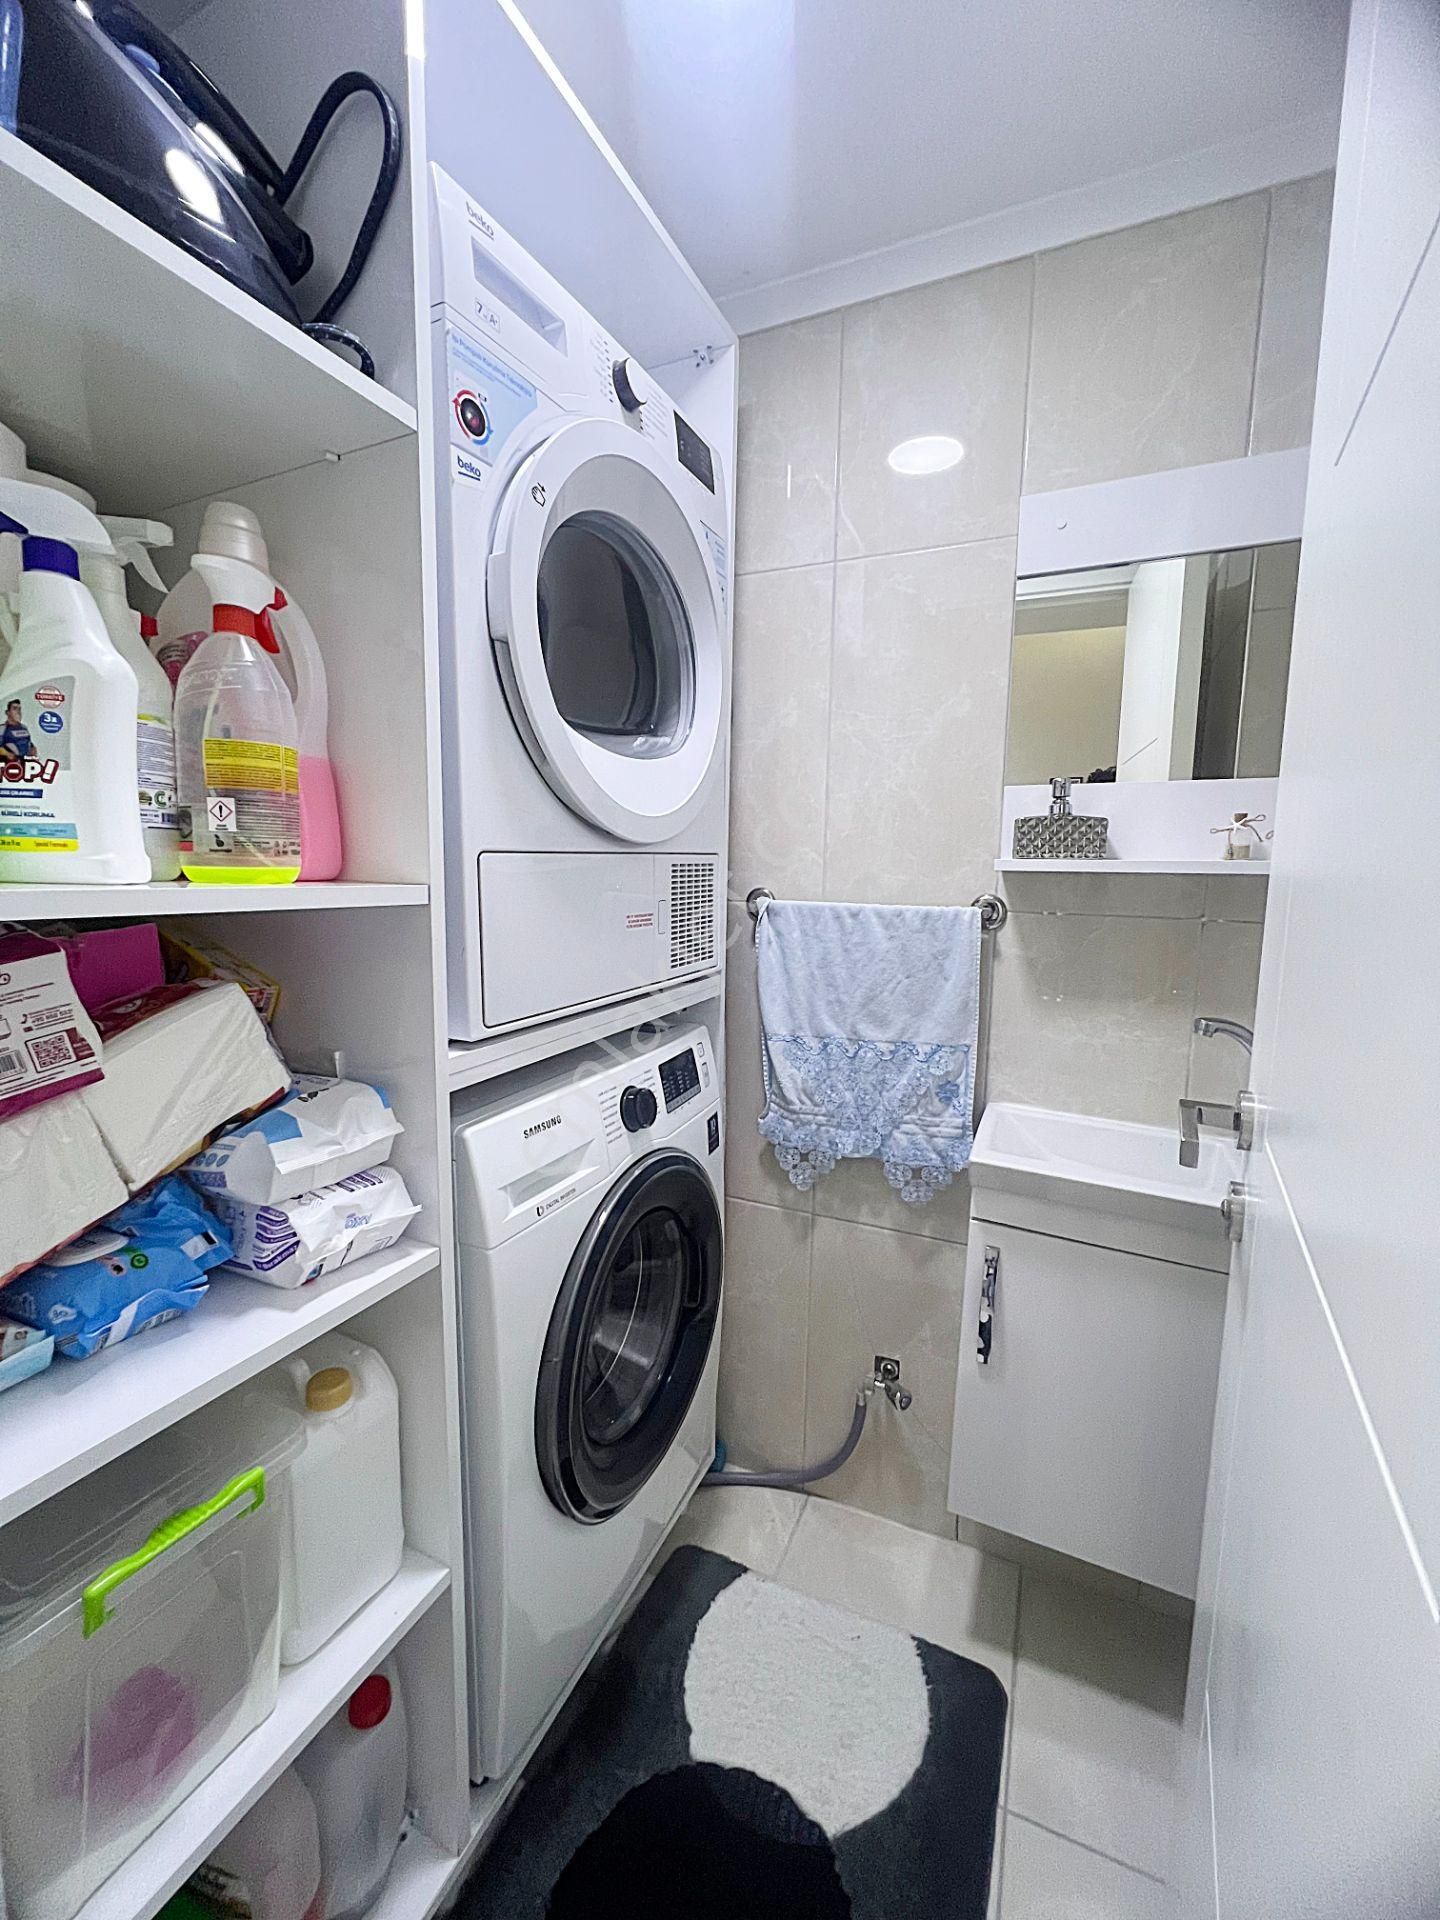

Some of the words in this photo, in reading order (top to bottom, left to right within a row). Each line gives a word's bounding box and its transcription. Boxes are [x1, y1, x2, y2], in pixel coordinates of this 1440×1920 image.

[466, 201, 494, 236] beko
[457, 455, 481, 477] beko
[523, 1115, 562, 1139] SAMSUNG
